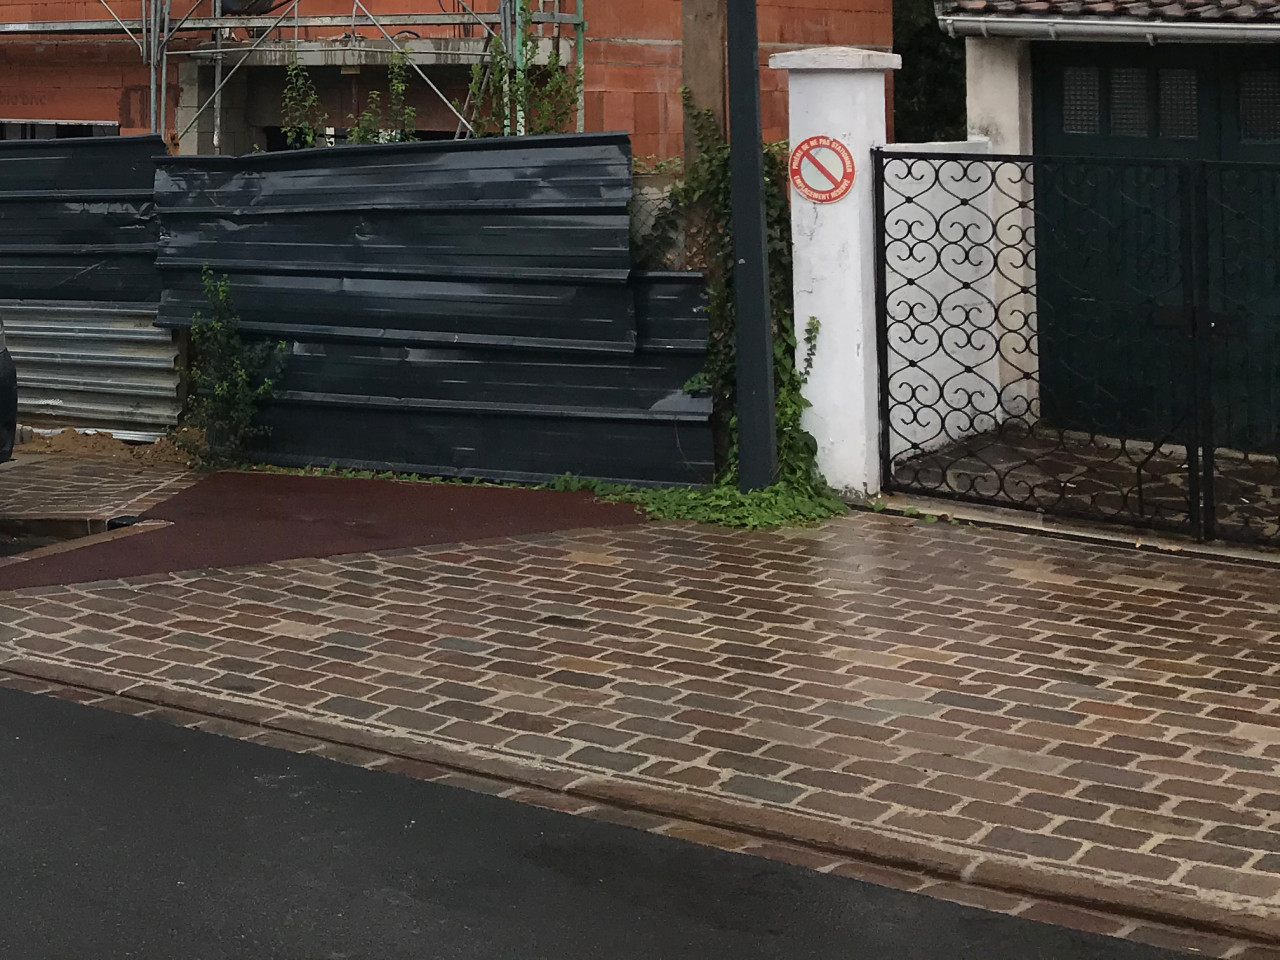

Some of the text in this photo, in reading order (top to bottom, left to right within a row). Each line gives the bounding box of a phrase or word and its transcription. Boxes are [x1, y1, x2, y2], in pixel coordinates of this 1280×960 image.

[801, 142, 810, 151] DE
[809, 139, 818, 147] NE
[819, 138, 831, 146] PAS
[831, 141, 853, 173] STATIONNER
[793, 175, 830, 200] EMPLACEMENT
